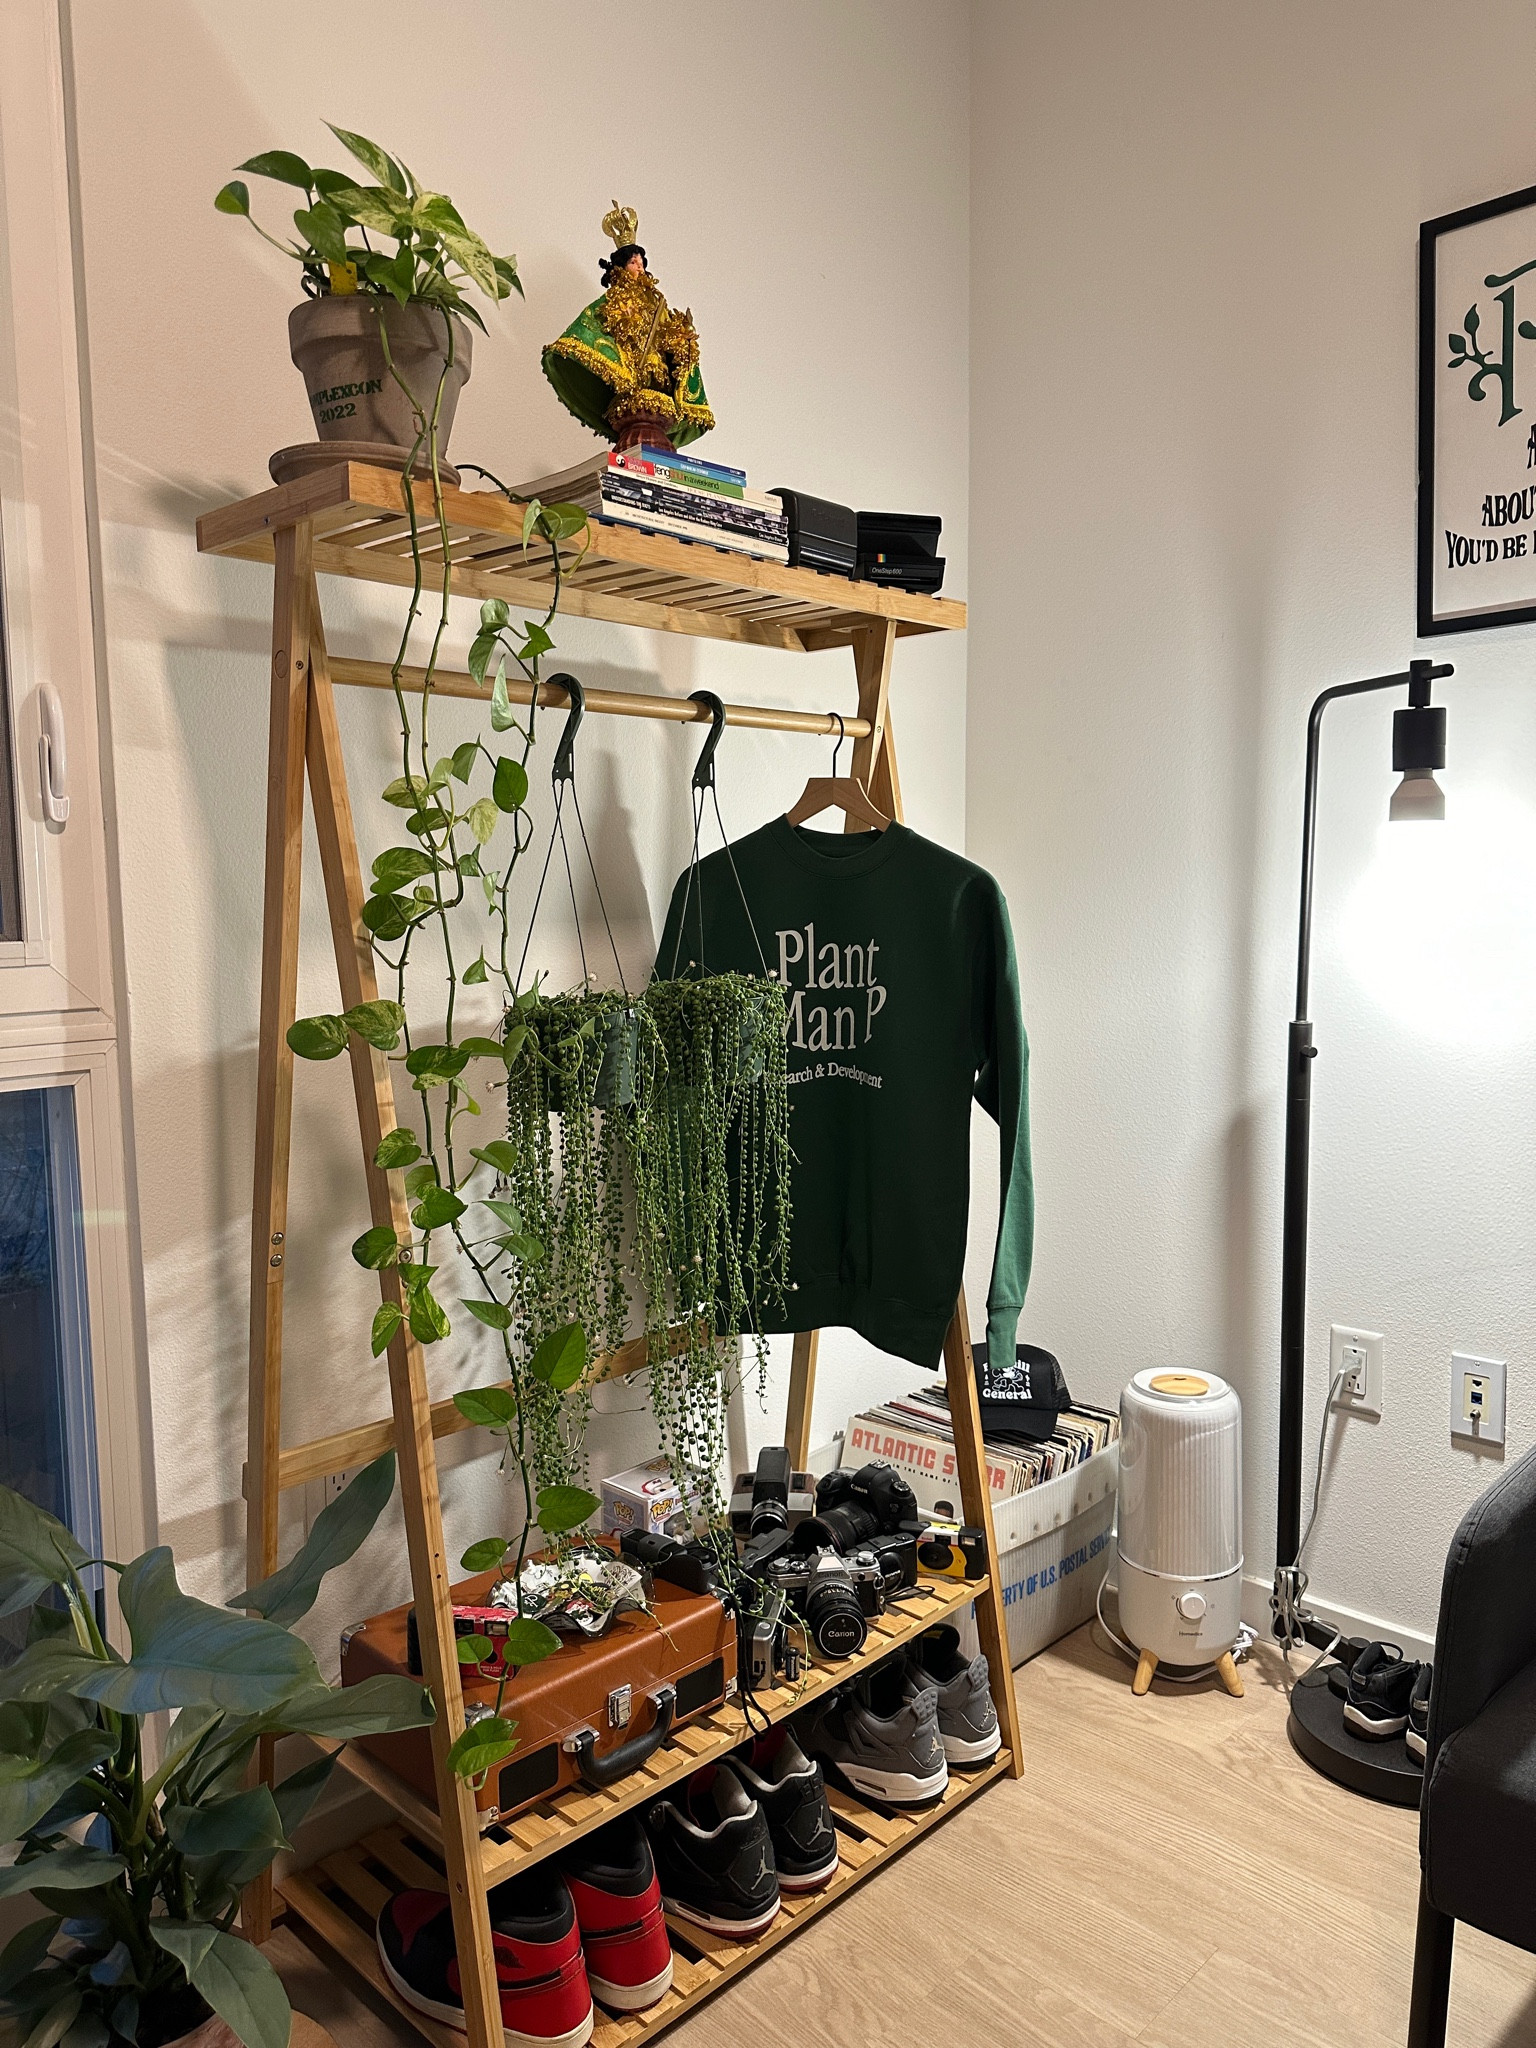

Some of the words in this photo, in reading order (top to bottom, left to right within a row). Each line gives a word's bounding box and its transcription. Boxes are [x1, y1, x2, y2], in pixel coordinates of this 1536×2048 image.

[319, 402, 357, 424] 2022
[627, 462, 648, 474] BROWN
[654, 463, 671, 480] feng
[1444, 530, 1499, 569] YOU'D
[1502, 534, 1528, 560] BE
[775, 922, 880, 990] Plant
[864, 985, 887, 1043] P
[815, 1063, 825, 1078] &
[827, 1062, 883, 1089] Development
[982, 1388, 1033, 1400] General
[851, 1427, 937, 1470] ATLANTIC
[850, 1483, 868, 1494] Canon
[1026, 1573, 1039, 1595] OF
[1040, 1565, 1058, 1589] U.S.
[1059, 1545, 1088, 1579] POSTAL
[827, 1630, 855, 1638] Canon
